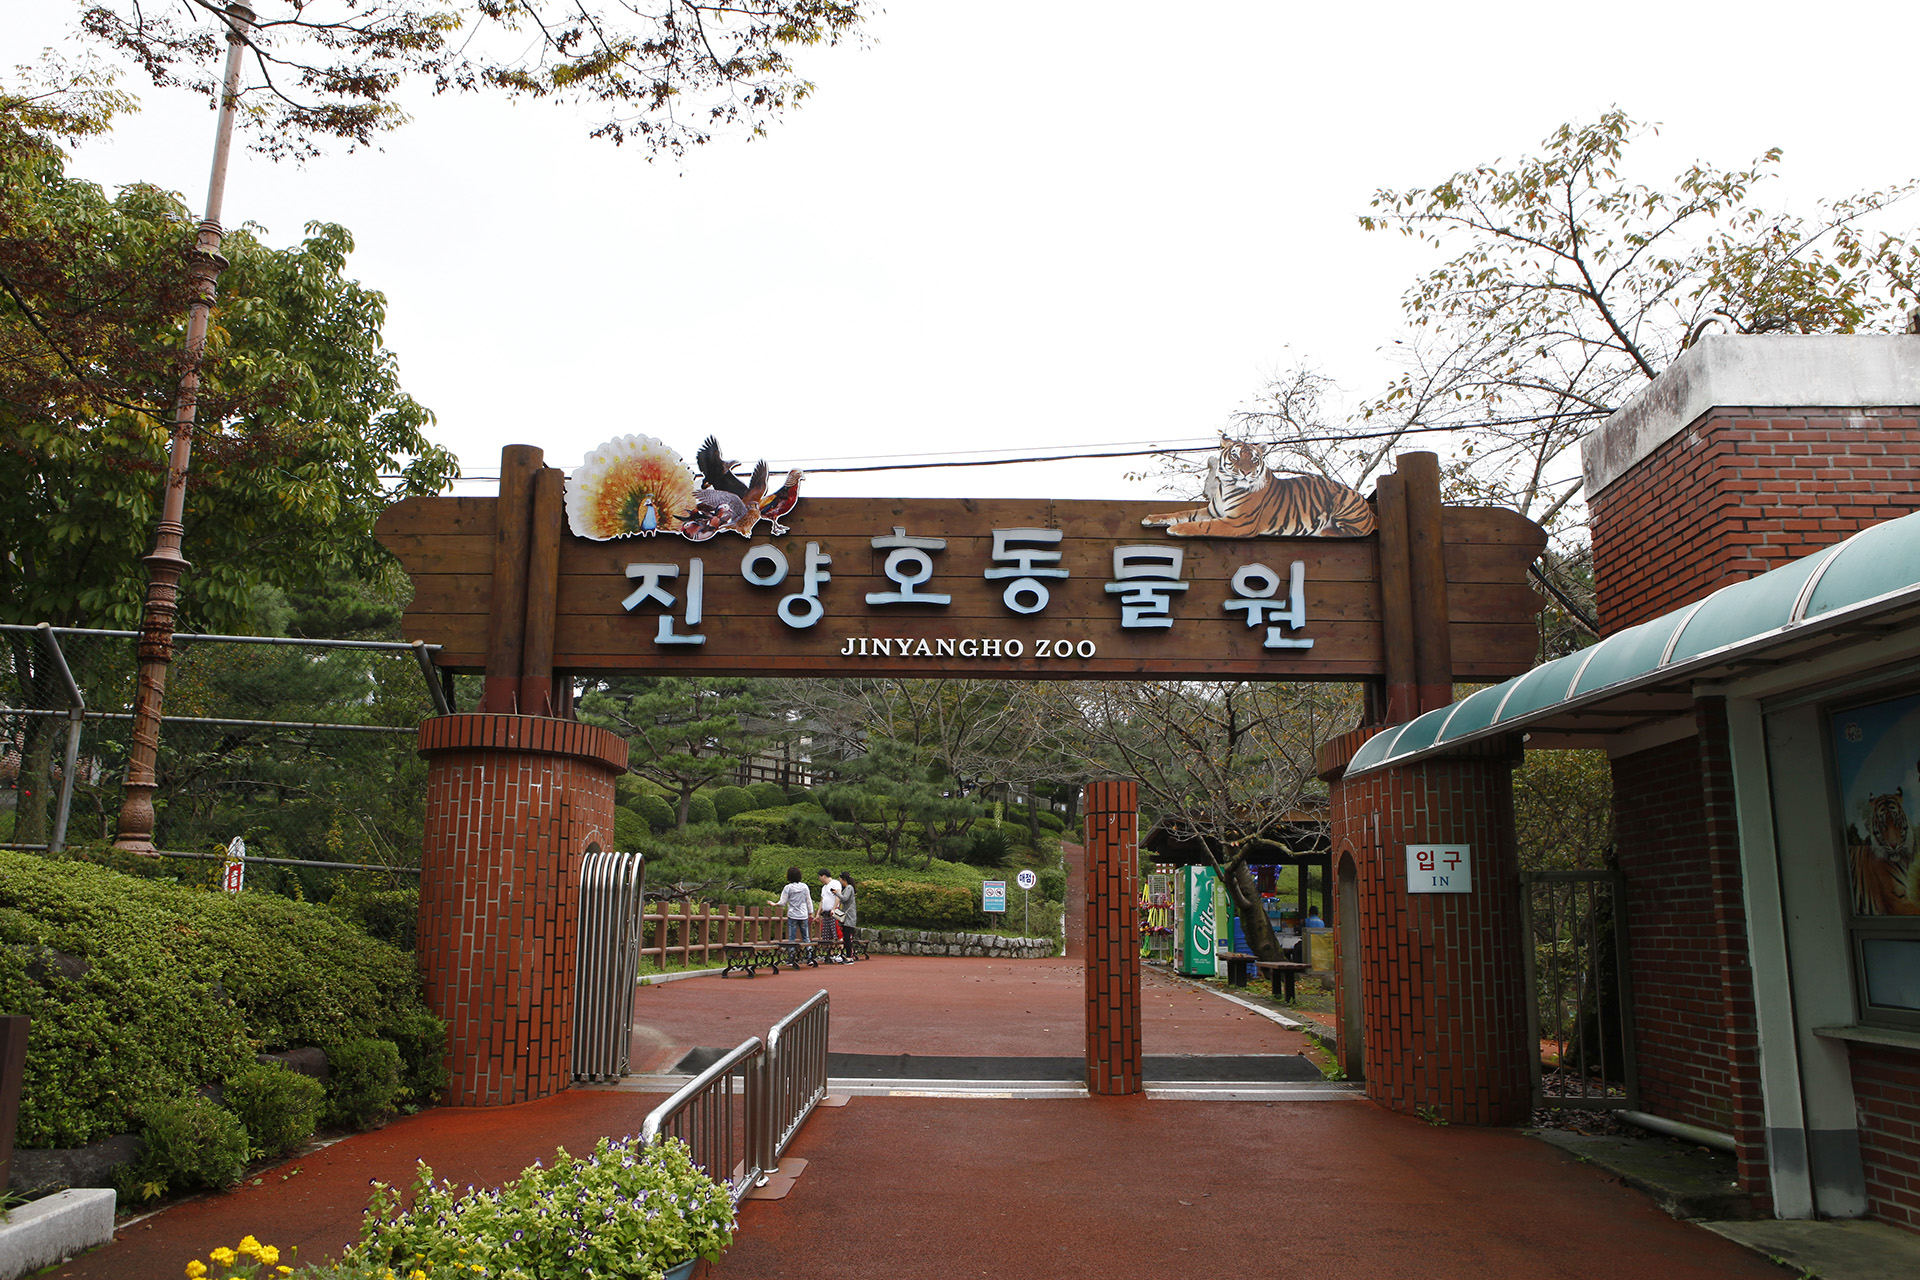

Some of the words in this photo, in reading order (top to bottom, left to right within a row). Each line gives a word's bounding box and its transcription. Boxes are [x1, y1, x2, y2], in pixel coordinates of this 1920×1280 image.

[621, 526, 1314, 650] 진양호동물원
[841, 638, 1024, 658] JINYANGHO
[1034, 639, 1097, 658] ZOO
[1416, 850, 1462, 871] 입구
[1432, 876, 1449, 887] IN
